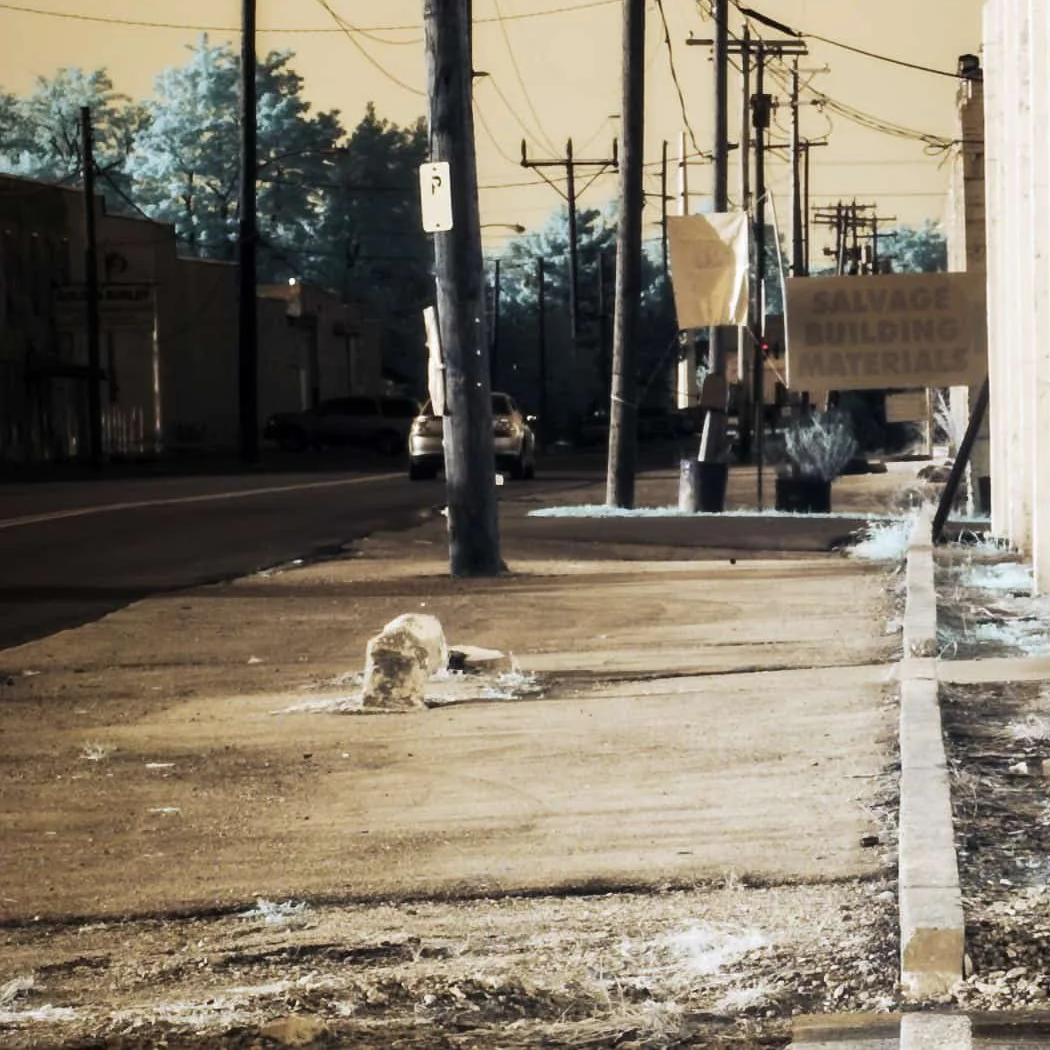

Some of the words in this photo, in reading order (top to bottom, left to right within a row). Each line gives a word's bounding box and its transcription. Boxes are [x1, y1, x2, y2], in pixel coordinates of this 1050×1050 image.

[812, 286, 949, 314] SALVAGE
[803, 318, 959, 346] BUILDING
[798, 348, 968, 378] MATERIALS
